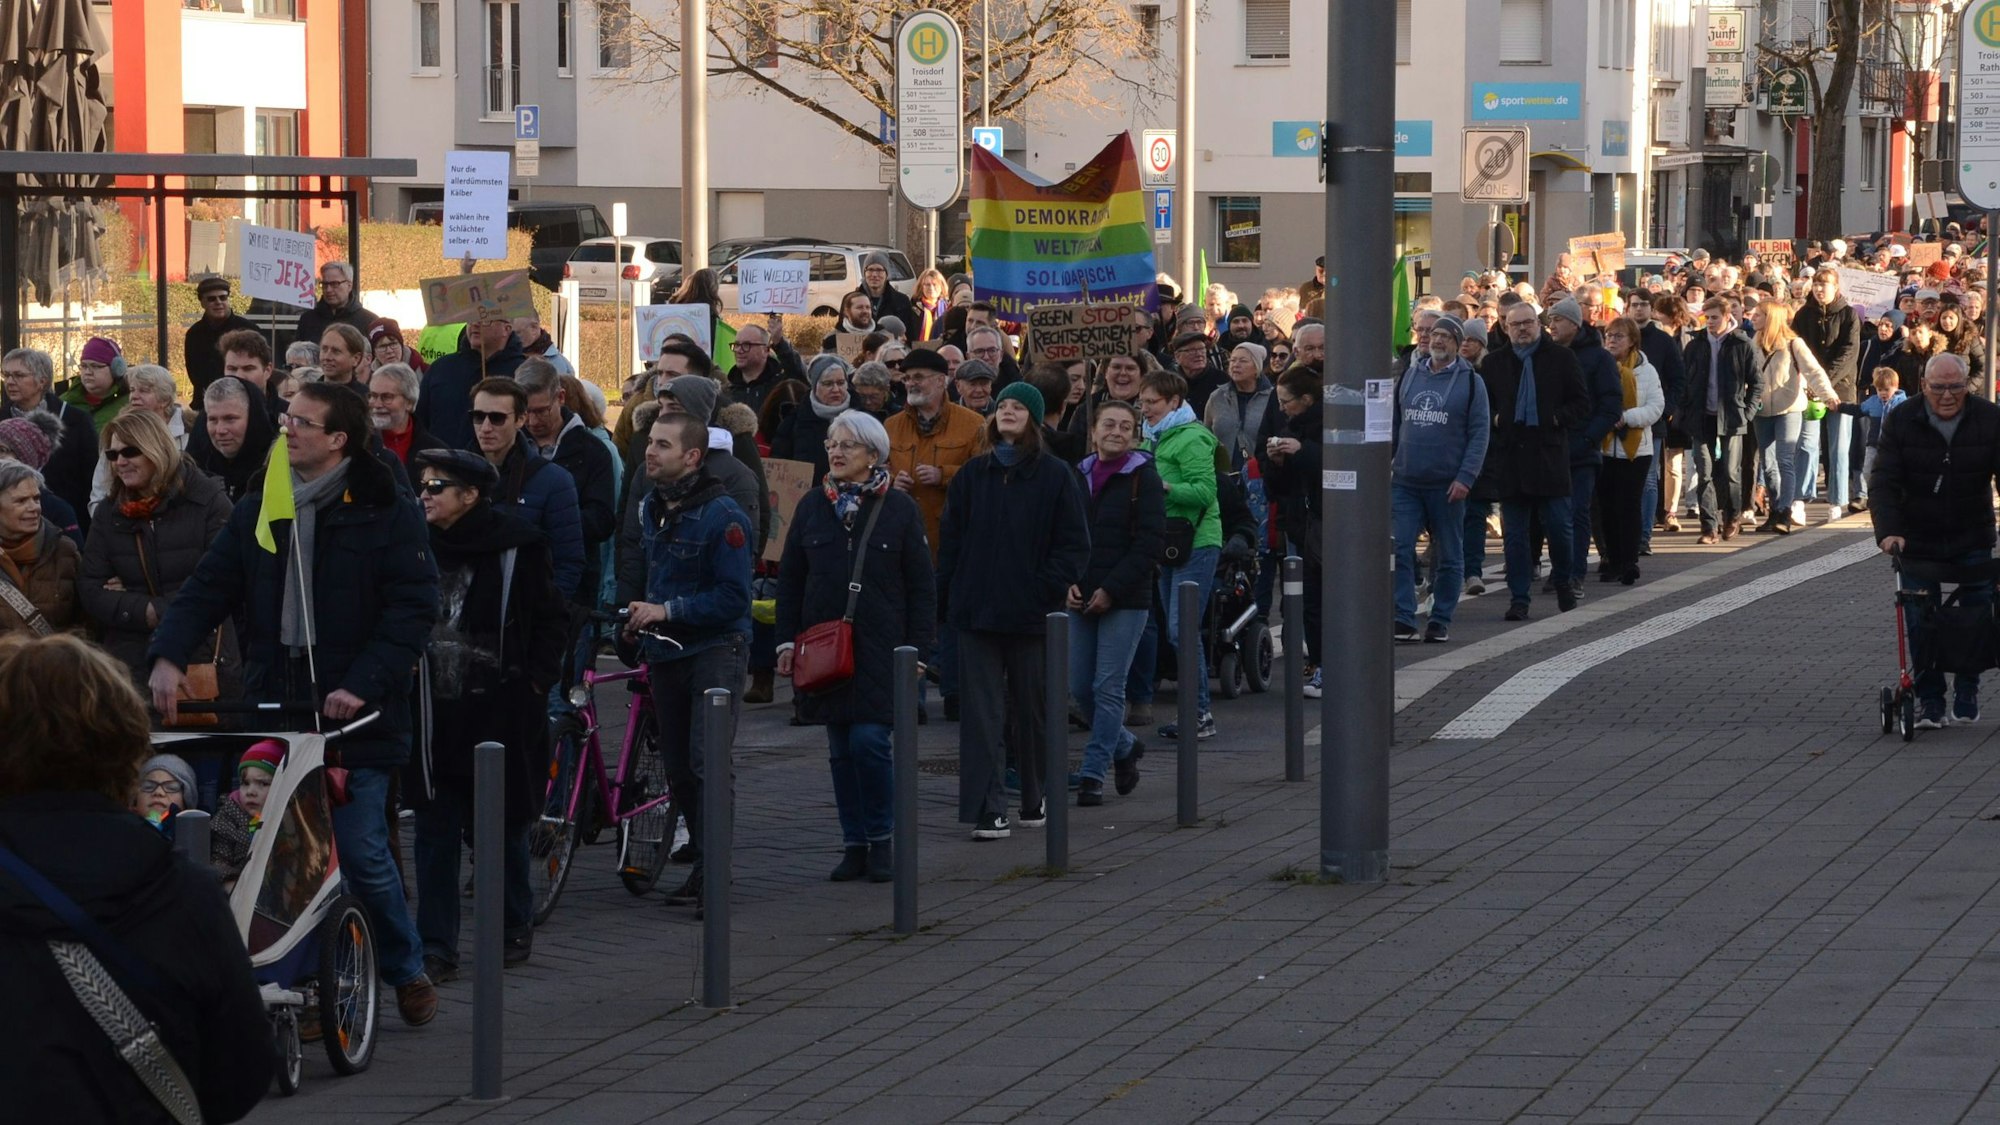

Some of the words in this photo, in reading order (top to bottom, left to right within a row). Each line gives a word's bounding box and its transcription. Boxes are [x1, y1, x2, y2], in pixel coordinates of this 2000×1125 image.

[919, 31, 936, 56] H
[1978, 51, 2000, 60] Trois
[912, 67, 944, 76] Troisdorf
[913, 78, 942, 86] Rathaus
[1501, 94, 1569, 107] sportwetten.de
[1974, 107, 1989, 115] 507
[520, 109, 534, 135] P
[1969, 120, 1983, 128] 508
[912, 128, 927, 137] 508
[1154, 147, 1167, 162] 30
[1483, 148, 1507, 169] 20
[451, 165, 464, 173] Nur
[465, 165, 476, 173] die
[450, 178, 503, 186] allerdümmsten
[1152, 173, 1169, 183] ZONE
[450, 189, 472, 197] Kälber
[1479, 184, 1508, 196] ZONE
[449, 213, 475, 221] wählen
[476, 213, 490, 221] ihre
[448, 225, 485, 233] Schlächter
[249, 231, 269, 250] NIE
[273, 236, 313, 260] WIEDER
[448, 237, 470, 245] selber
[475, 237, 489, 245] AfD
[1772, 241, 1790, 252] BIN
[248, 261, 272, 283] IST
[741, 269, 757, 284] NIE
[763, 268, 804, 284] WIEDER
[743, 291, 759, 305] IST
[762, 285, 808, 305] JETZT!
[1030, 309, 1074, 328] GEGEN
[1081, 305, 1132, 326] STOP
[1044, 345, 1080, 360] STOP
[1081, 340, 1133, 358] ISMUS!
